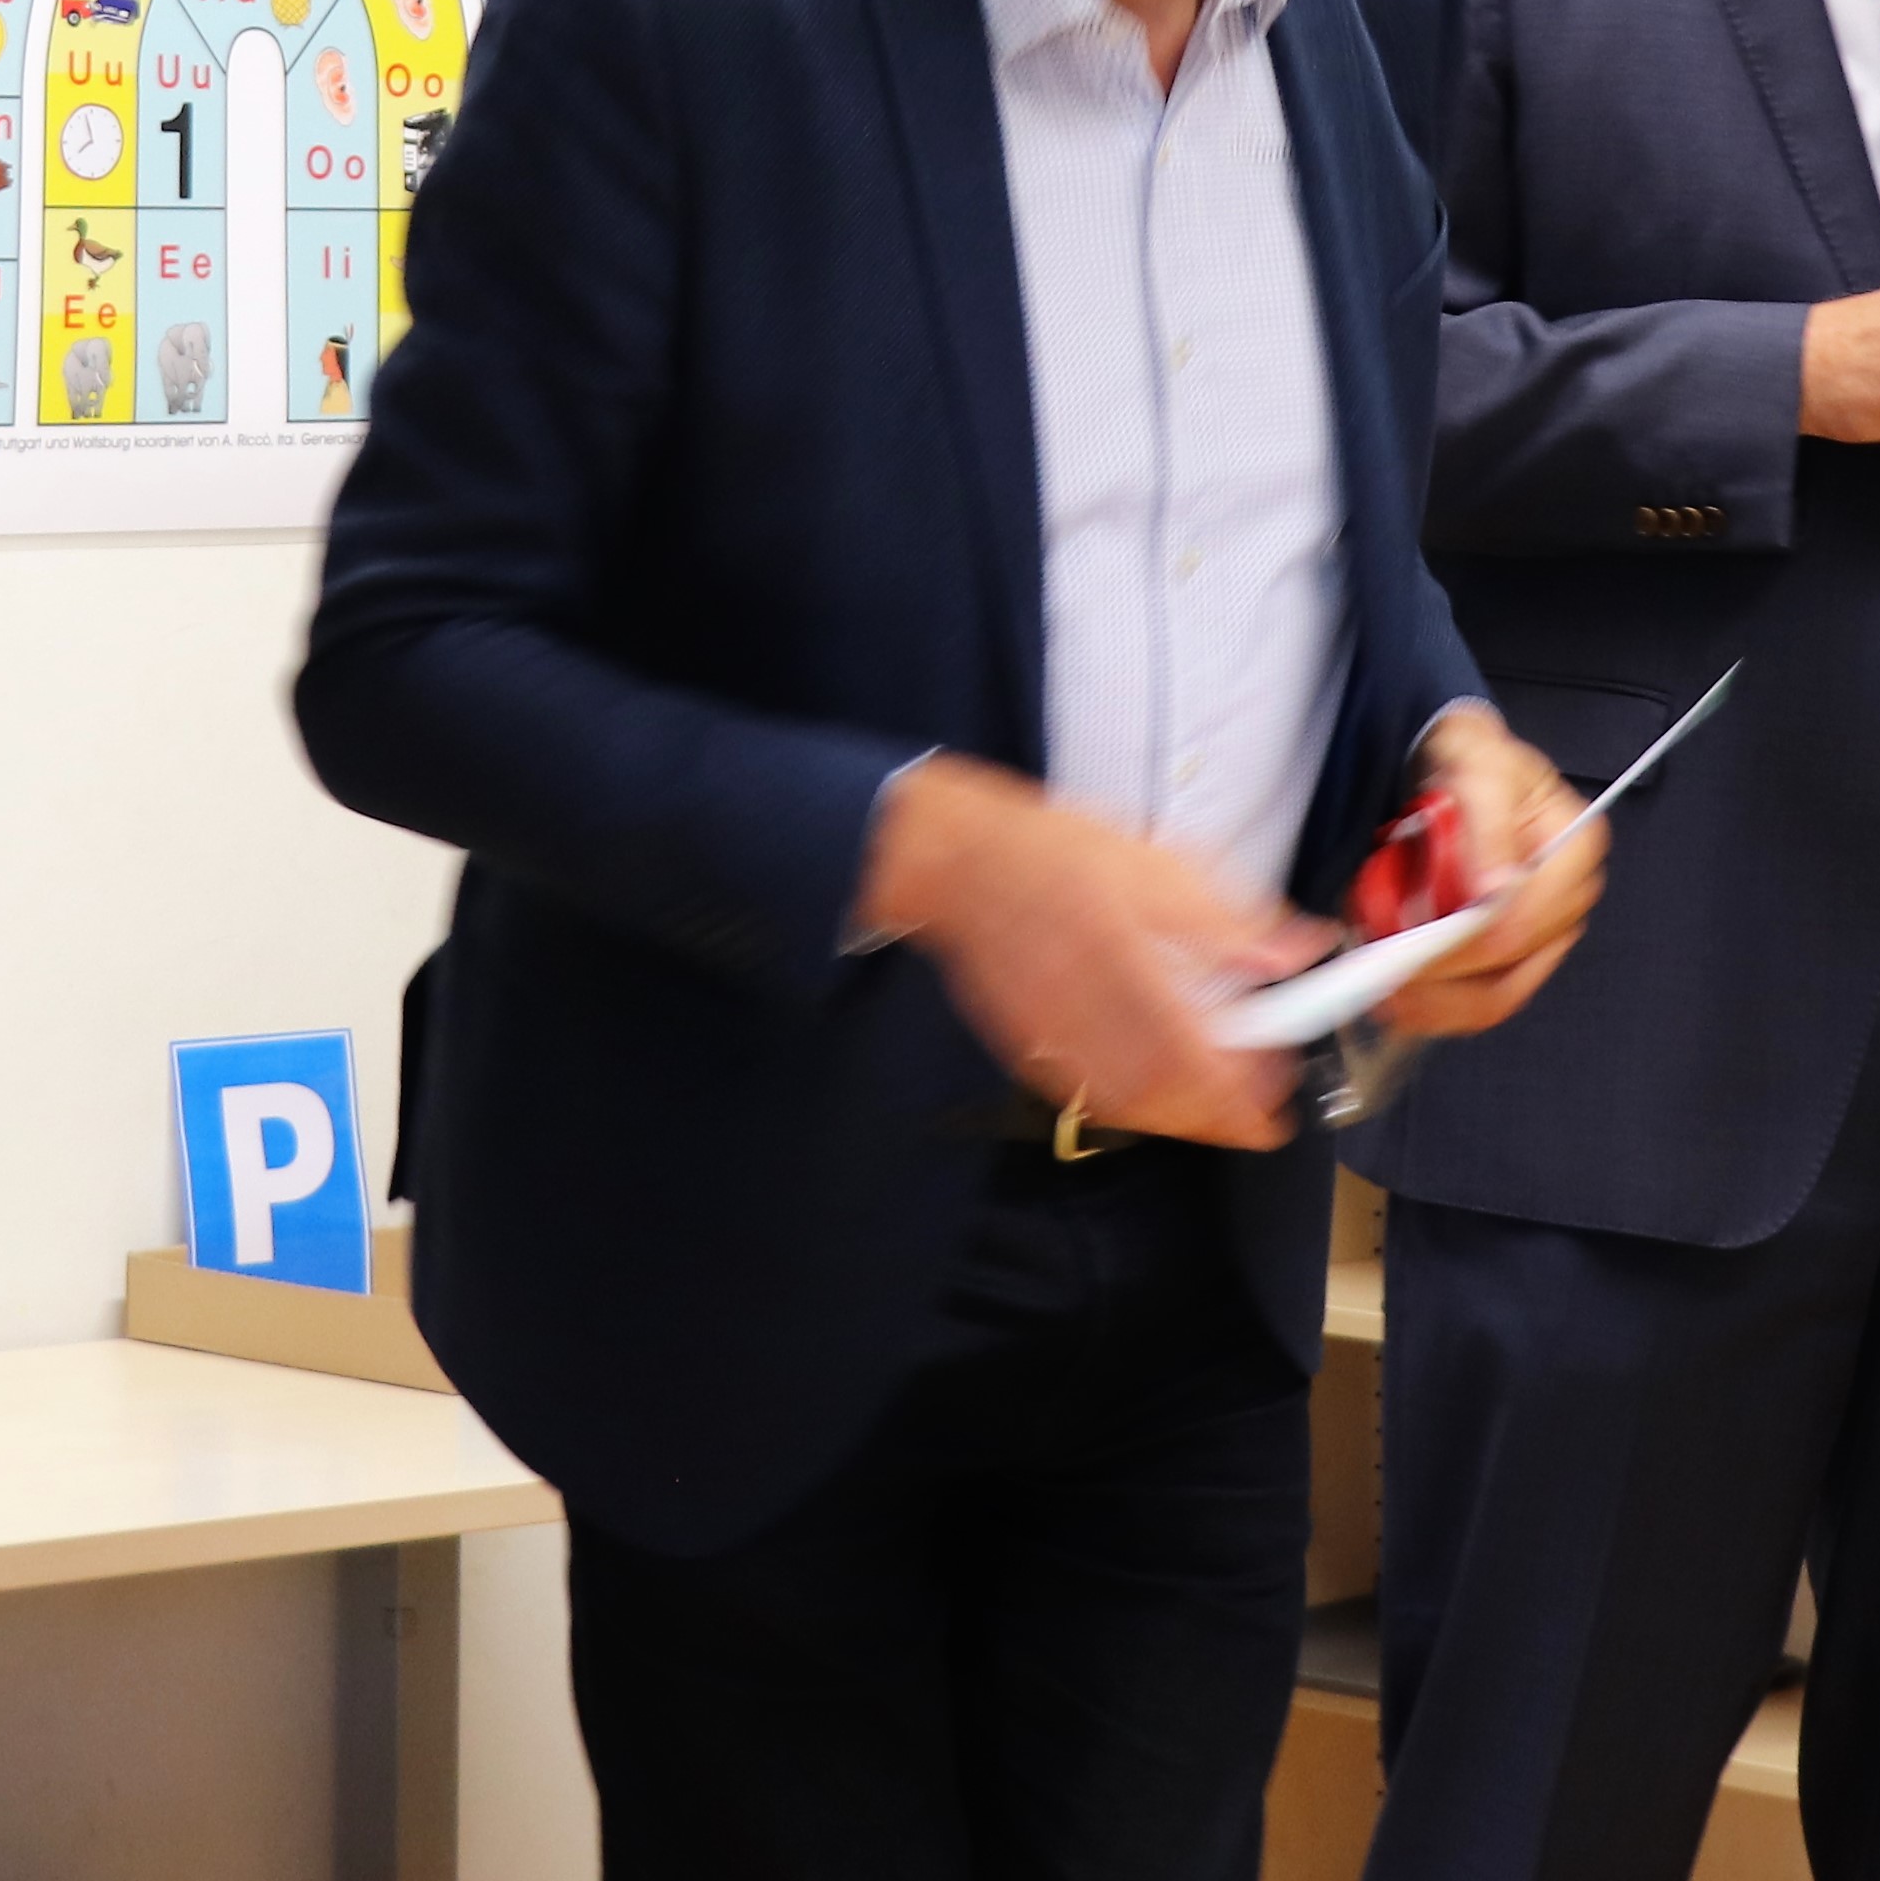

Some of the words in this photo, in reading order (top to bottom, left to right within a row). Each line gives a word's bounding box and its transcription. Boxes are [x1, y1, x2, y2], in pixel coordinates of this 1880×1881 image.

[161, 103, 191, 199] 1
[72, 435, 131, 452] Wolfsburg
[134, 434, 196, 449] koordiniert
[221, 1081, 335, 1266] P
